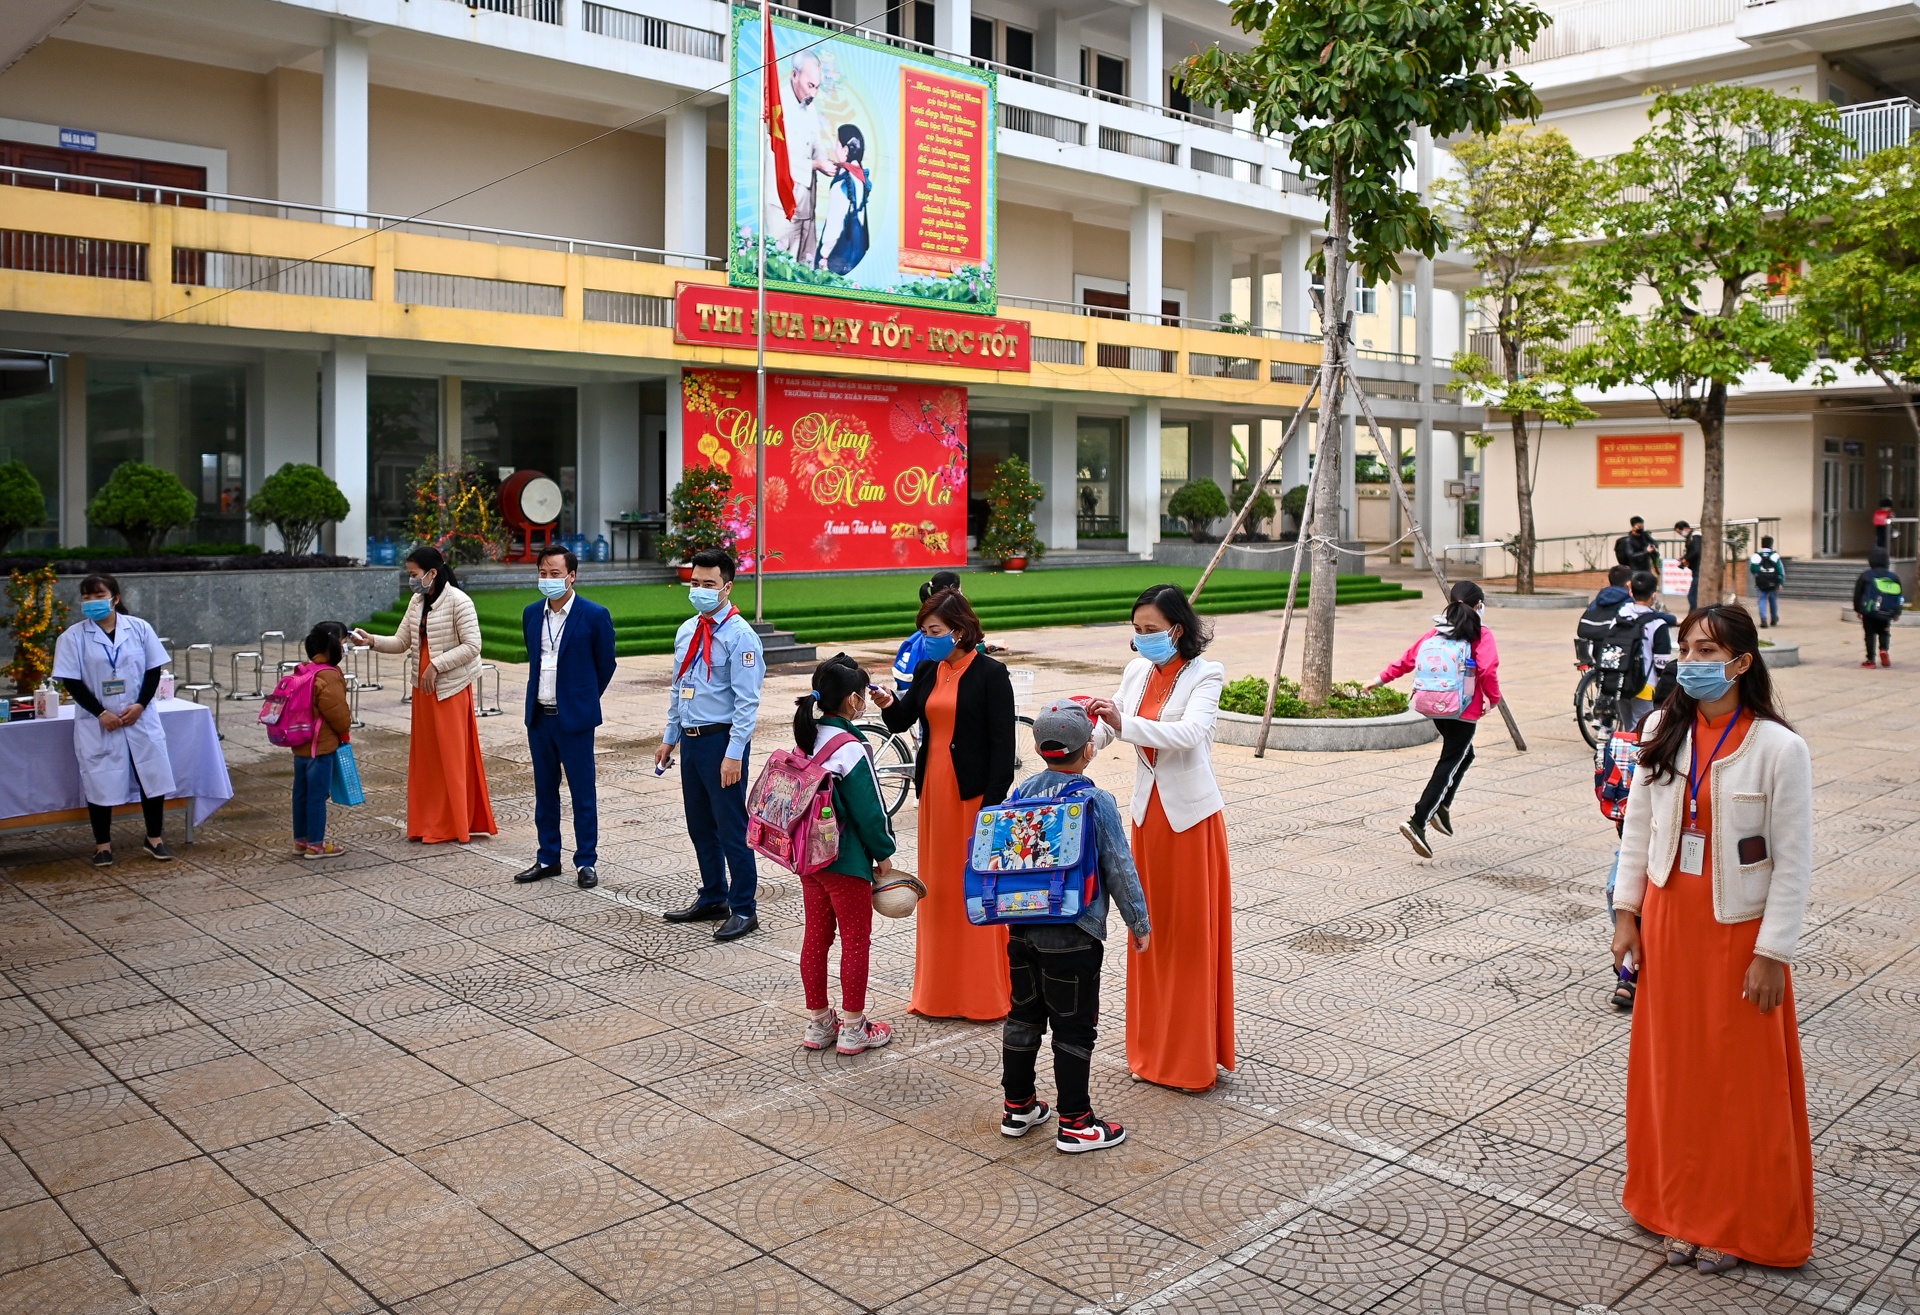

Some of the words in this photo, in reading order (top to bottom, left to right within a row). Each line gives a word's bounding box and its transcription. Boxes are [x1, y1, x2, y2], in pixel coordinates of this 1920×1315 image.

[965, 93, 981, 104] Nam
[957, 126, 974, 138] Nam
[696, 303, 743, 334] THI
[752, 309, 806, 340] ĐUA
[812, 315, 863, 349] DẠY
[869, 312, 914, 349] TỐT
[928, 327, 974, 359] HỌC
[979, 324, 1018, 358] TỐT
[792, 412, 870, 461] Mừng
[812, 465, 886, 507] Năm
[894, 466, 953, 507] Mới
[824, 519, 850, 534] Xuân
[852, 518, 869, 534] Tân
[890, 522, 918, 539] 2021
